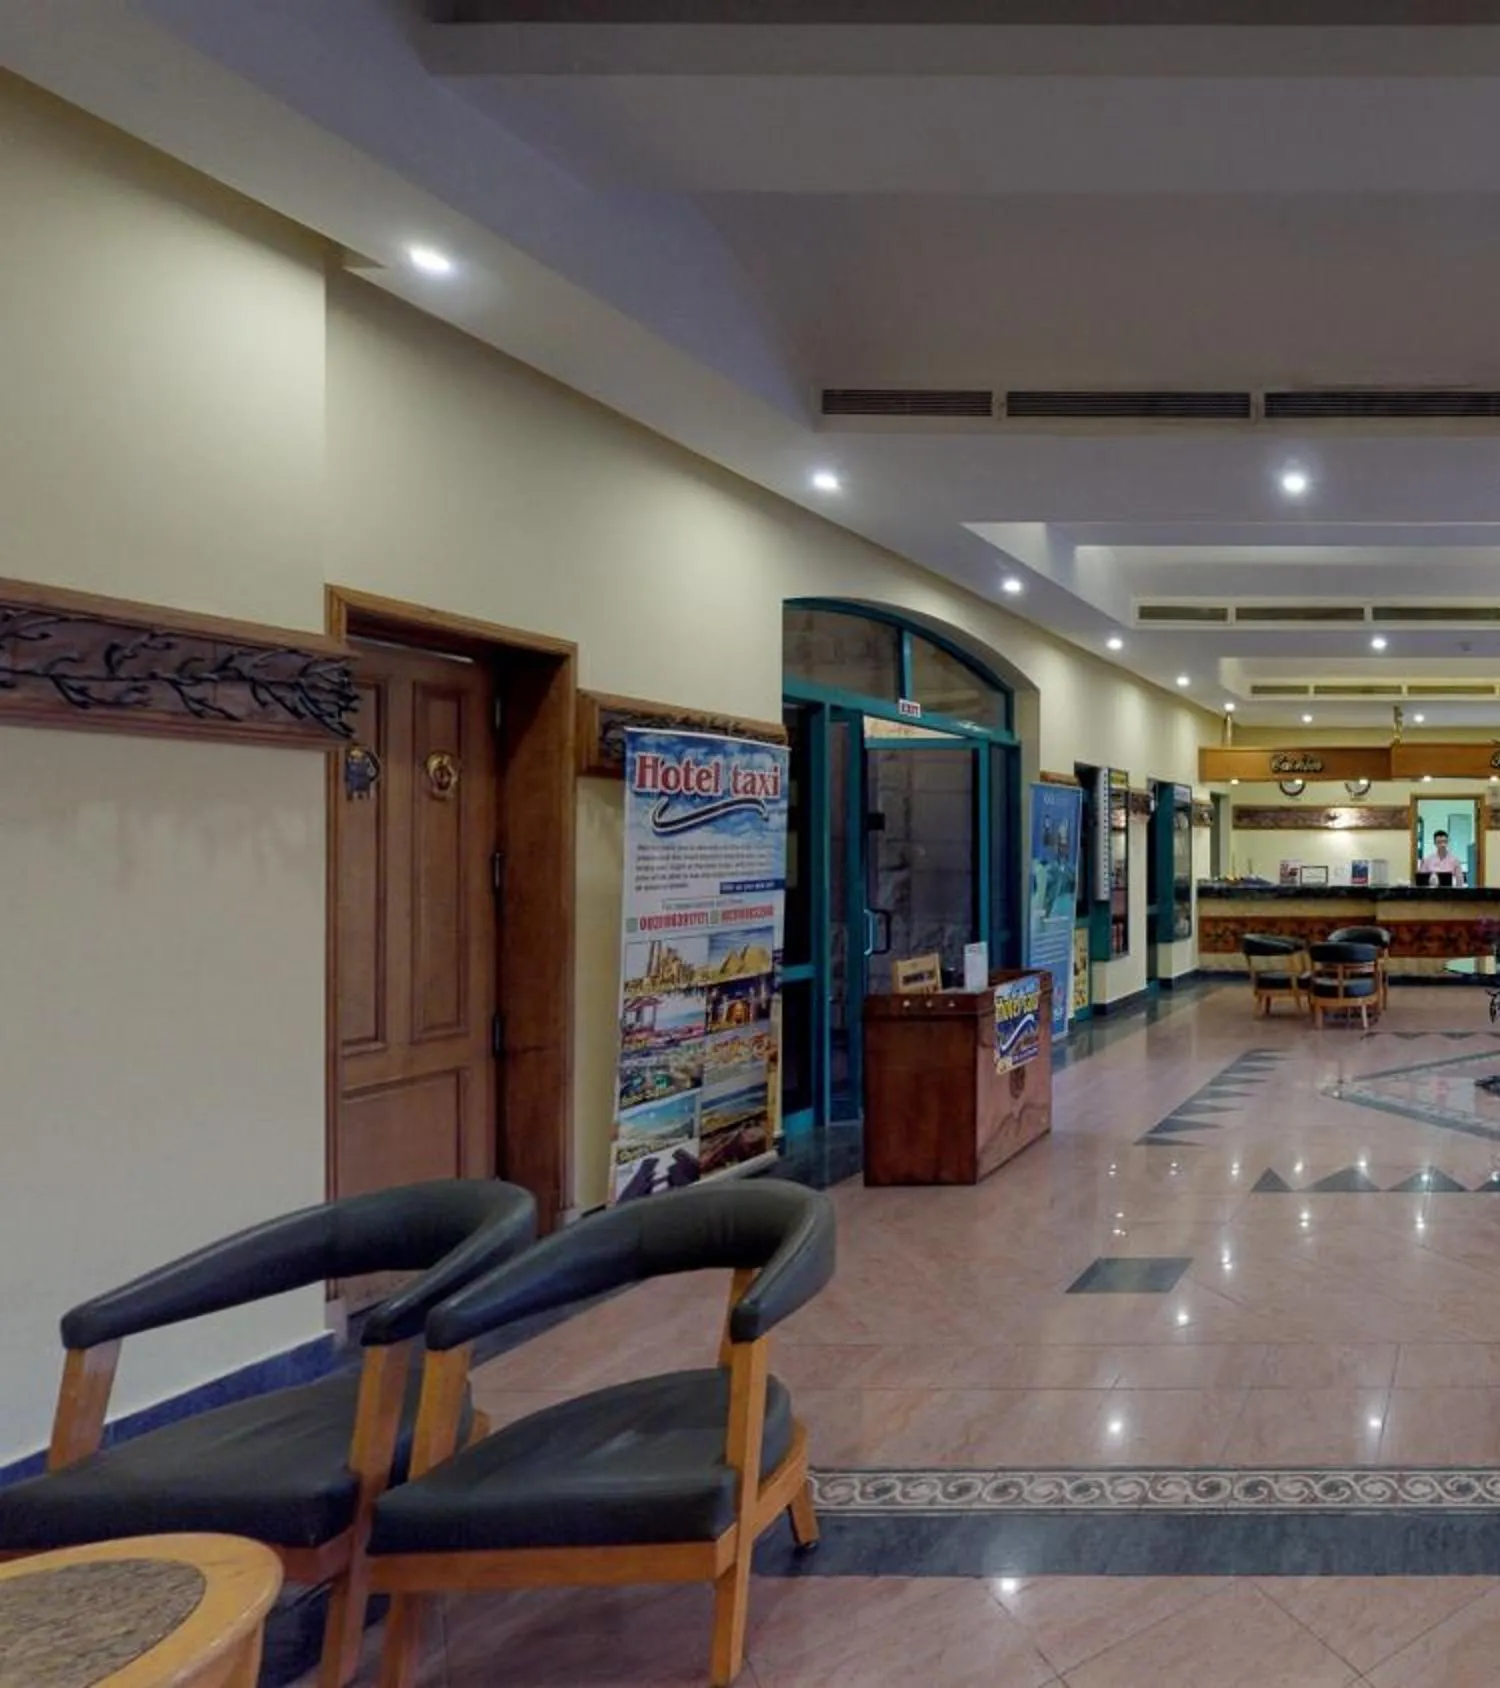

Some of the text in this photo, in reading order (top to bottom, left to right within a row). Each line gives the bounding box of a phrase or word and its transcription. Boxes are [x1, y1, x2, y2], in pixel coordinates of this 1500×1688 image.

[901, 702, 919, 715] EXIT
[635, 754, 781, 797] Hotel taxi
